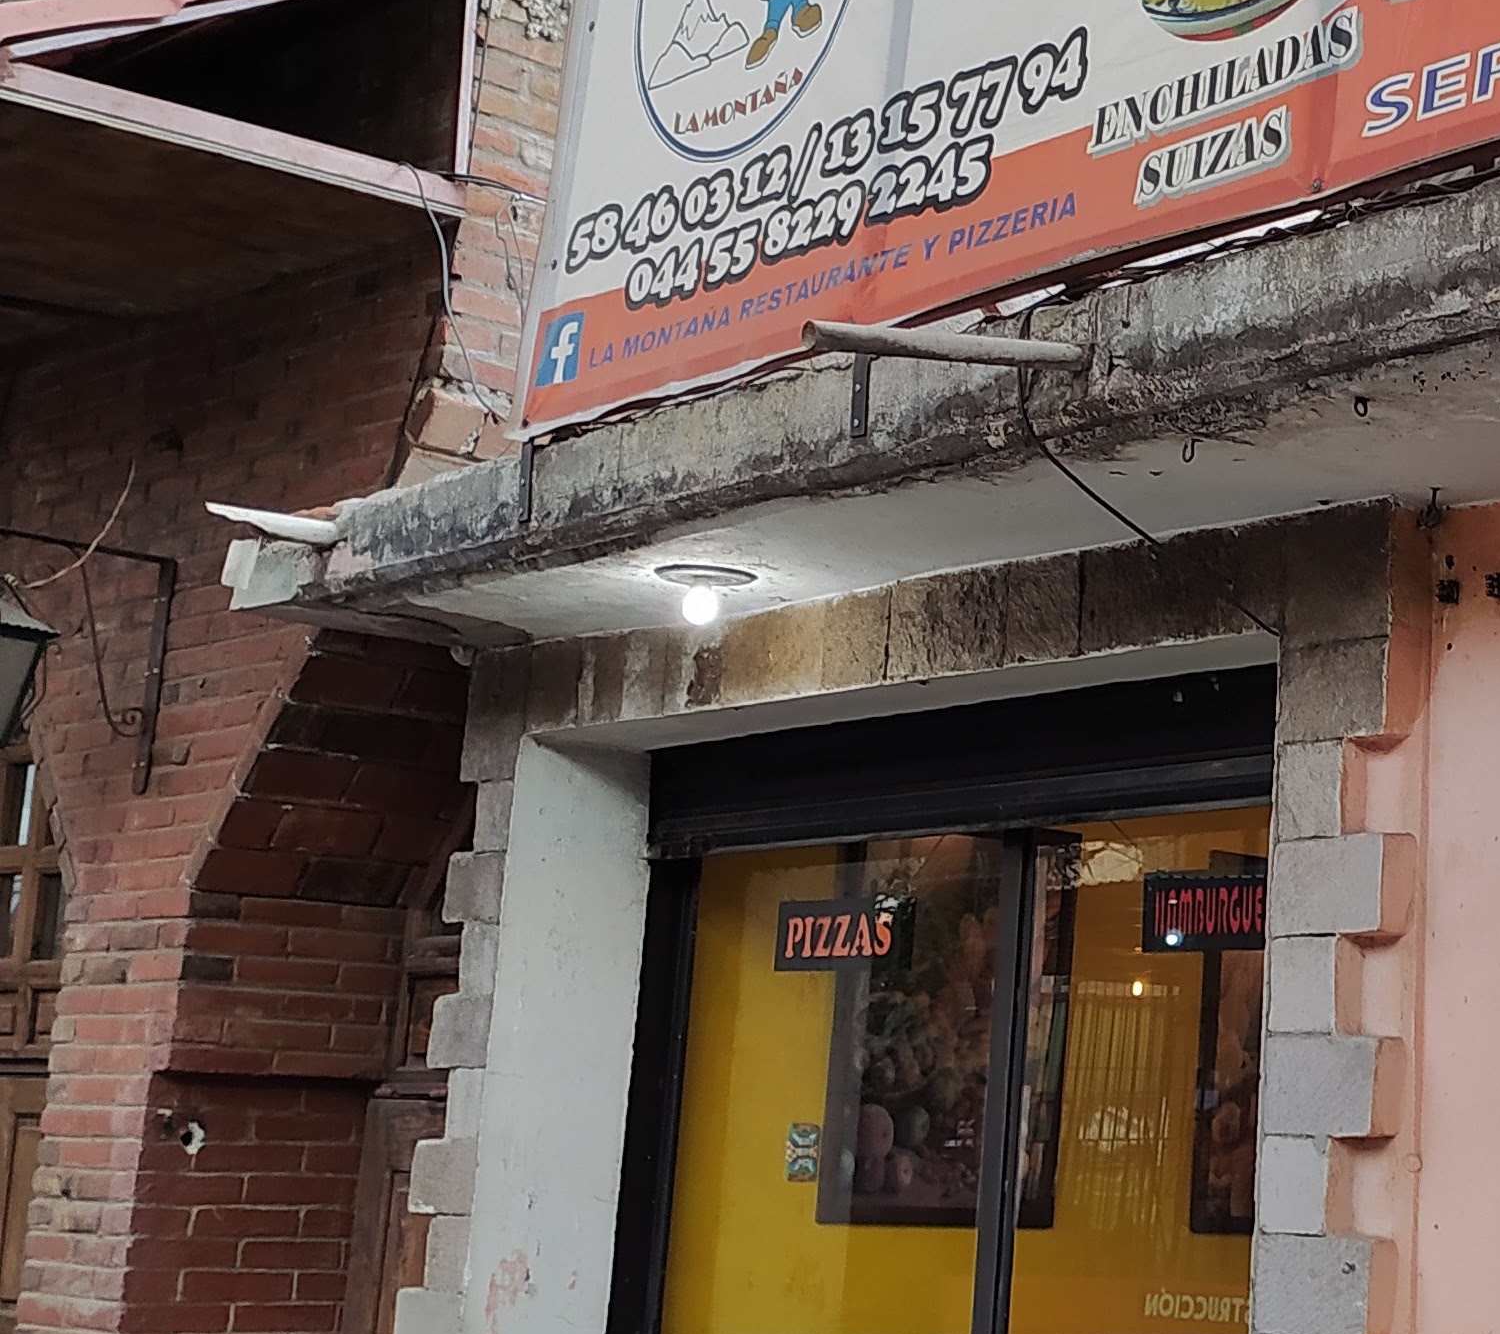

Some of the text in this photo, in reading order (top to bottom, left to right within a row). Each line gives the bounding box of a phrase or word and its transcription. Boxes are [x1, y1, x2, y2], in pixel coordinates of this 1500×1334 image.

[674, 67, 803, 135] LA MONTAÑA
[1092, 11, 1357, 149] ENCHILADAS
[566, 204, 621, 274] 58
[622, 187, 679, 253] 46
[681, 169, 734, 232] 03
[737, 146, 793, 212] 12
[821, 108, 875, 176] 13
[880, 81, 943, 153] 15
[949, 58, 1018, 137] 77
[1018, 28, 1087, 114] 94
[1137, 110, 1284, 197] SUIZAS
[589, 192, 1077, 370] LA MONTAÑA RESTAURANTE Y PIZZERIA
[625, 135, 994, 309] 044 55 8229 2245
[784, 912, 892, 958] PIZZAS
